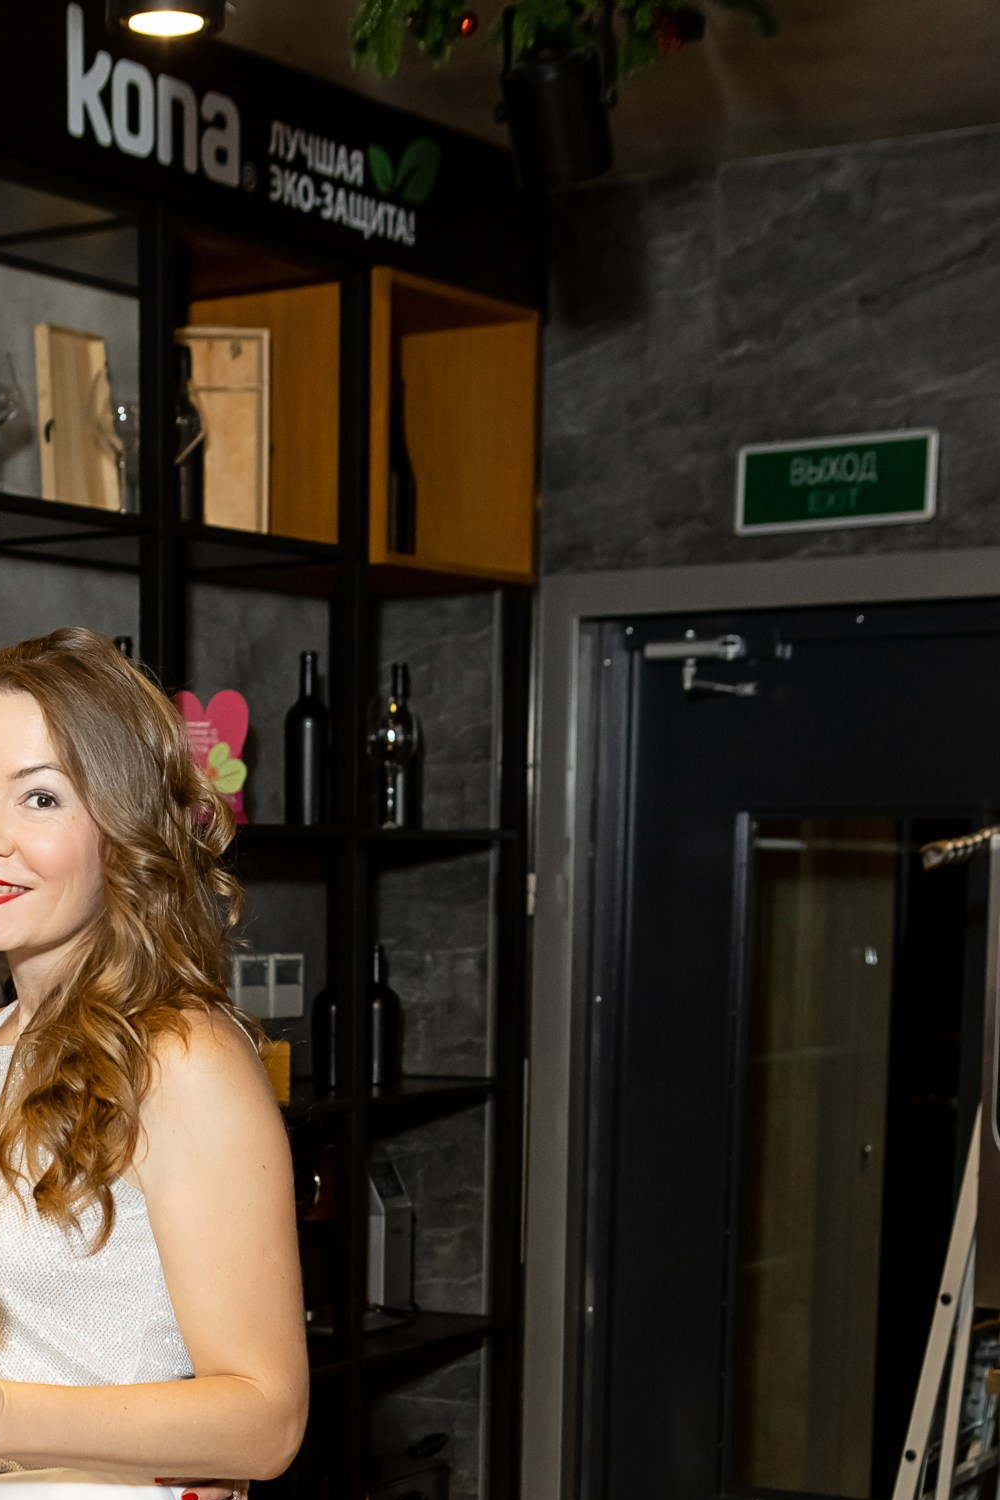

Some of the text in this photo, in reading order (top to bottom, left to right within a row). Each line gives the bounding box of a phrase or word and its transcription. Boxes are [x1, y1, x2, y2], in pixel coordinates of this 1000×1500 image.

[66, 2, 241, 189] kona
[268, 120, 364, 187] ЛУЧШАЯ
[268, 164, 416, 247] ЭКО-ЗАЩИТА!
[789, 450, 879, 487] ВЫХОД
[807, 486, 859, 514] EXIT
